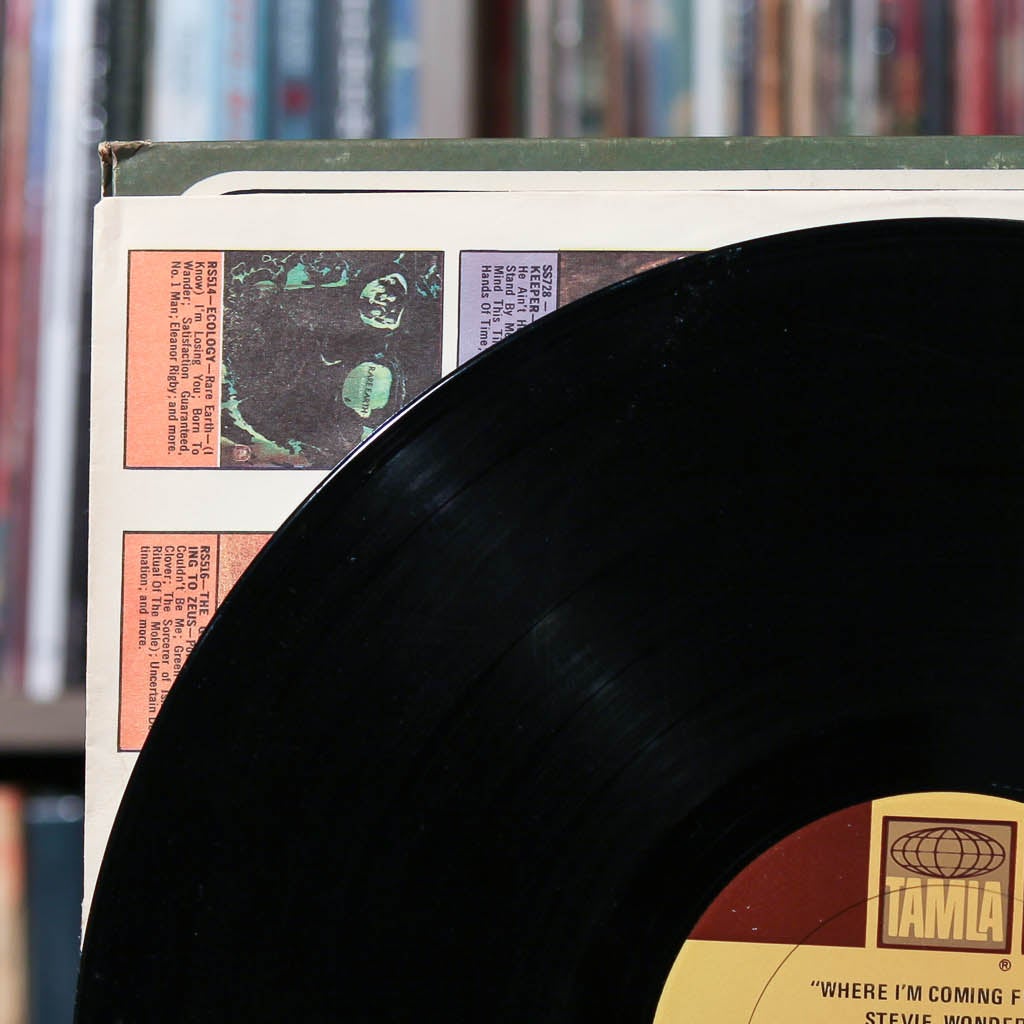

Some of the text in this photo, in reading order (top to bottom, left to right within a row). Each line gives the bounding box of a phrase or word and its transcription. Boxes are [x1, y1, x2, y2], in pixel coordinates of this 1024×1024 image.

[477, 265, 492, 351] Hands Of Time,
[492, 265, 504, 323] Mind This
[502, 265, 517, 316] Stand By
[516, 265, 529, 312] He Ain't
[166, 261, 182, 455] No. Man; Eleanor Rigby; and more.
[177, 260, 194, 456] Wander; Satisfaction Guaranteed,
[191, 261, 206, 455] Know) I'm Losing You; Born To
[151, 545, 163, 577] Ritual
[151, 580, 162, 592] Of
[187, 546, 198, 591] ING TO
[139, 595, 149, 615] and
[151, 596, 162, 617] The
[161, 545, 175, 683] Clover; The Sorcerer of
[172, 545, 187, 638] Couldn't Be Me;
[138, 619, 147, 649] more.
[148, 661, 160, 713] Uncertain
[884, 876, 1004, 942] TAMLA
[895, 984, 922, 1002] I'M
[928, 985, 1003, 1005] COMING
